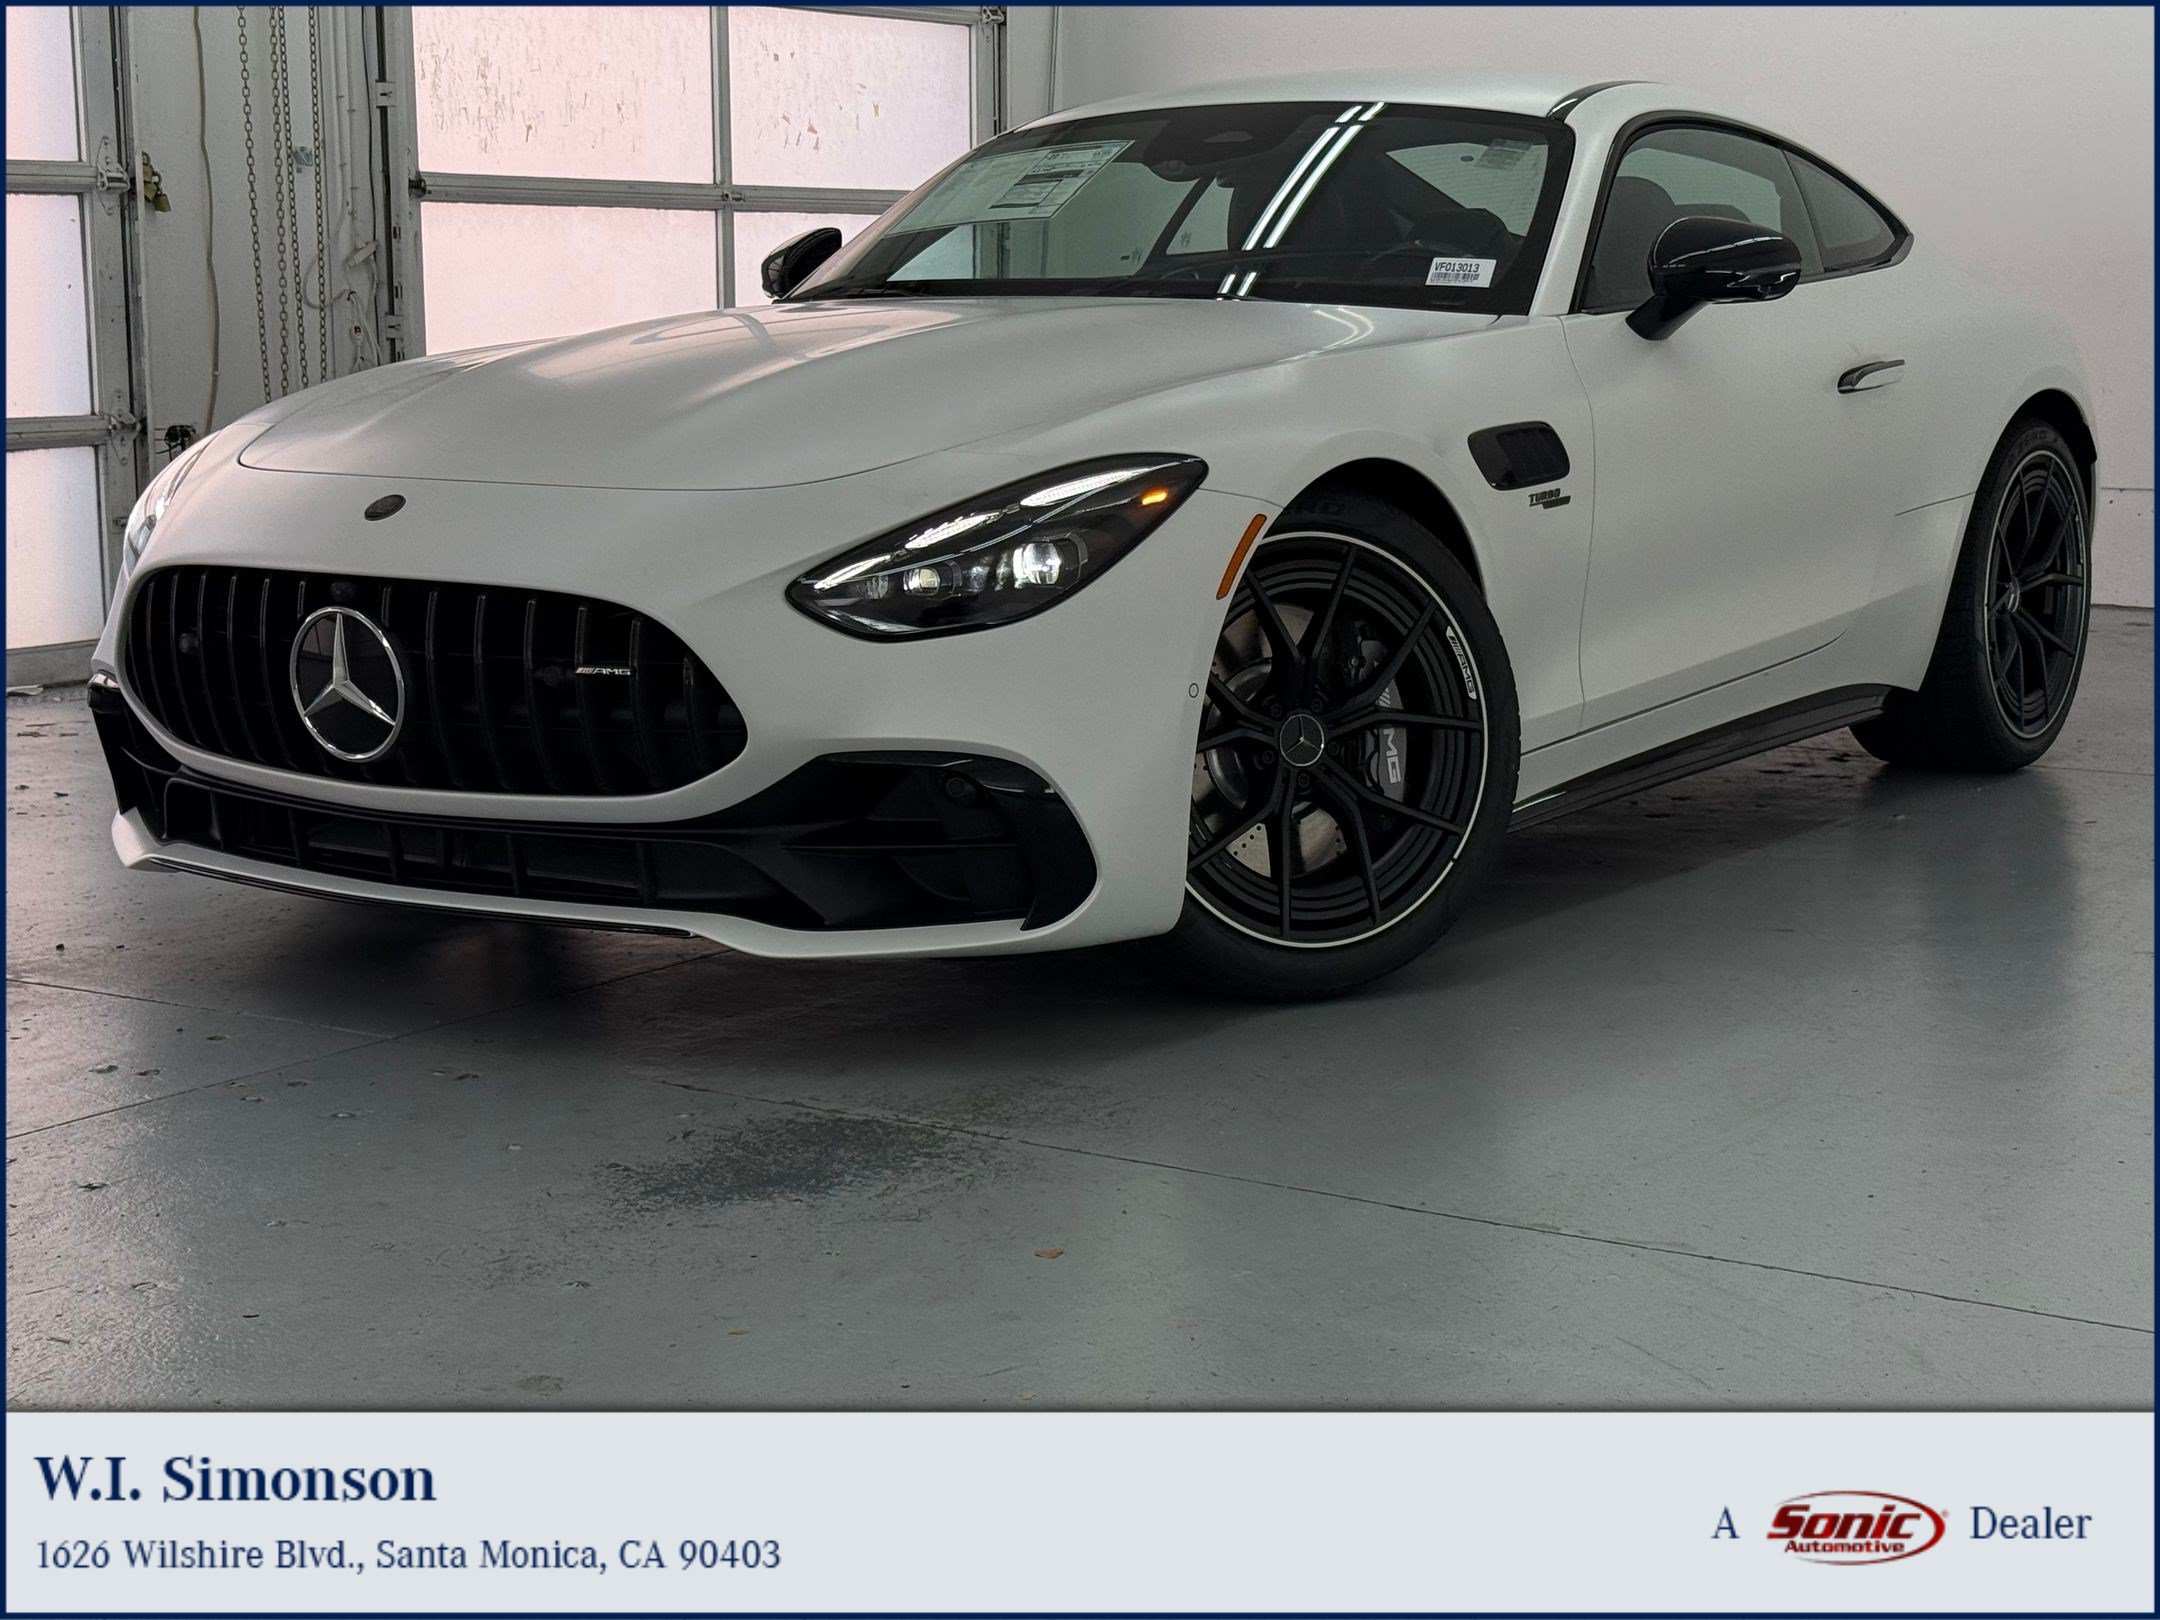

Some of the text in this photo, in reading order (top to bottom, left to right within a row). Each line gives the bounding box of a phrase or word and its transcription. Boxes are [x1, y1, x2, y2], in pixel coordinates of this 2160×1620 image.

[1435, 261, 1480, 273] VF013013
[1528, 488, 1561, 504] TURBO
[592, 667, 631, 676] AMG
[1383, 727, 1401, 784] MG
